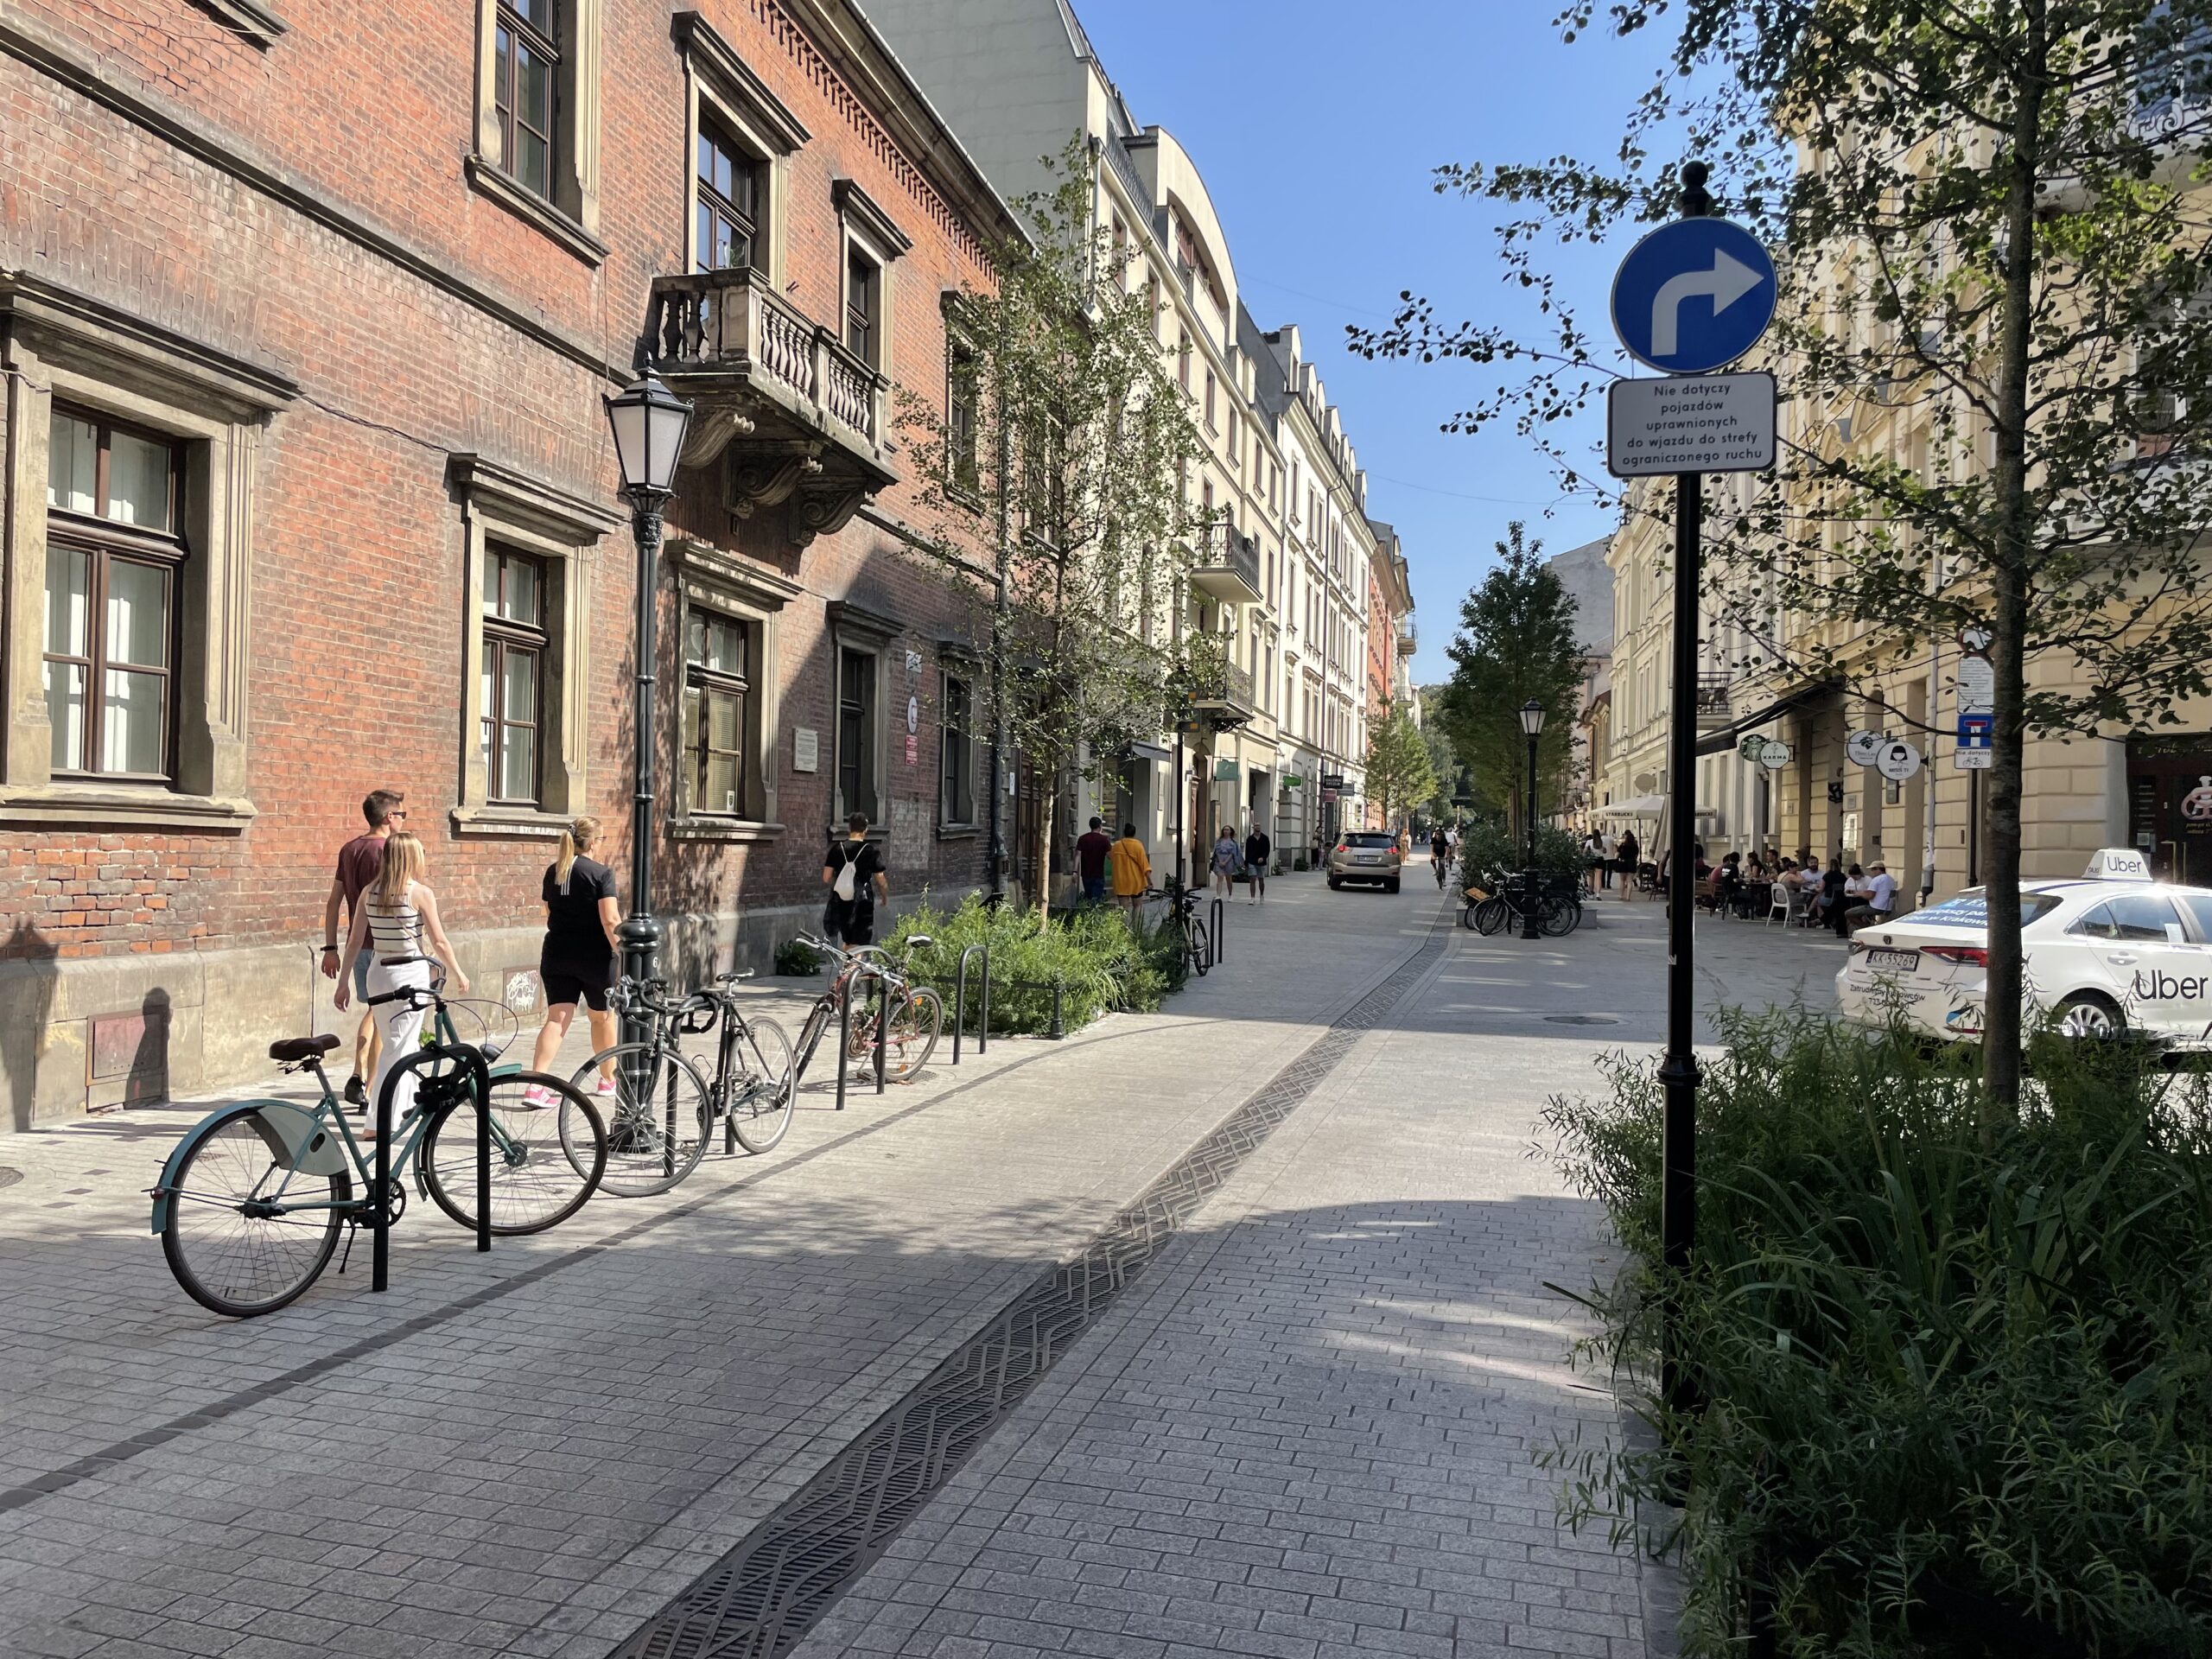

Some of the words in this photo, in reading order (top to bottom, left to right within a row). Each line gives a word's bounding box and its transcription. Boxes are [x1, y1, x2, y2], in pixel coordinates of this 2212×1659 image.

[1654, 385, 1676, 397] Nie
[1681, 384, 1731, 397] dotyczy
[1661, 400, 1724, 416] pojazdów
[1646, 416, 1738, 433] uprawnionych
[1627, 437, 1643, 448] do
[1649, 435, 1694, 449] wjazdu
[1699, 434, 1715, 445] do
[1721, 431, 1758, 444] strefy
[1622, 452, 1719, 467] ograniczonego
[1726, 449, 1762, 461] ruchu
[2107, 856, 2142, 873] Uber
[652, 957, 658, 969] 6
[1872, 952, 1885, 963] KK
[1886, 954, 1915, 967] 55269
[2134, 969, 2209, 1000] Uber
